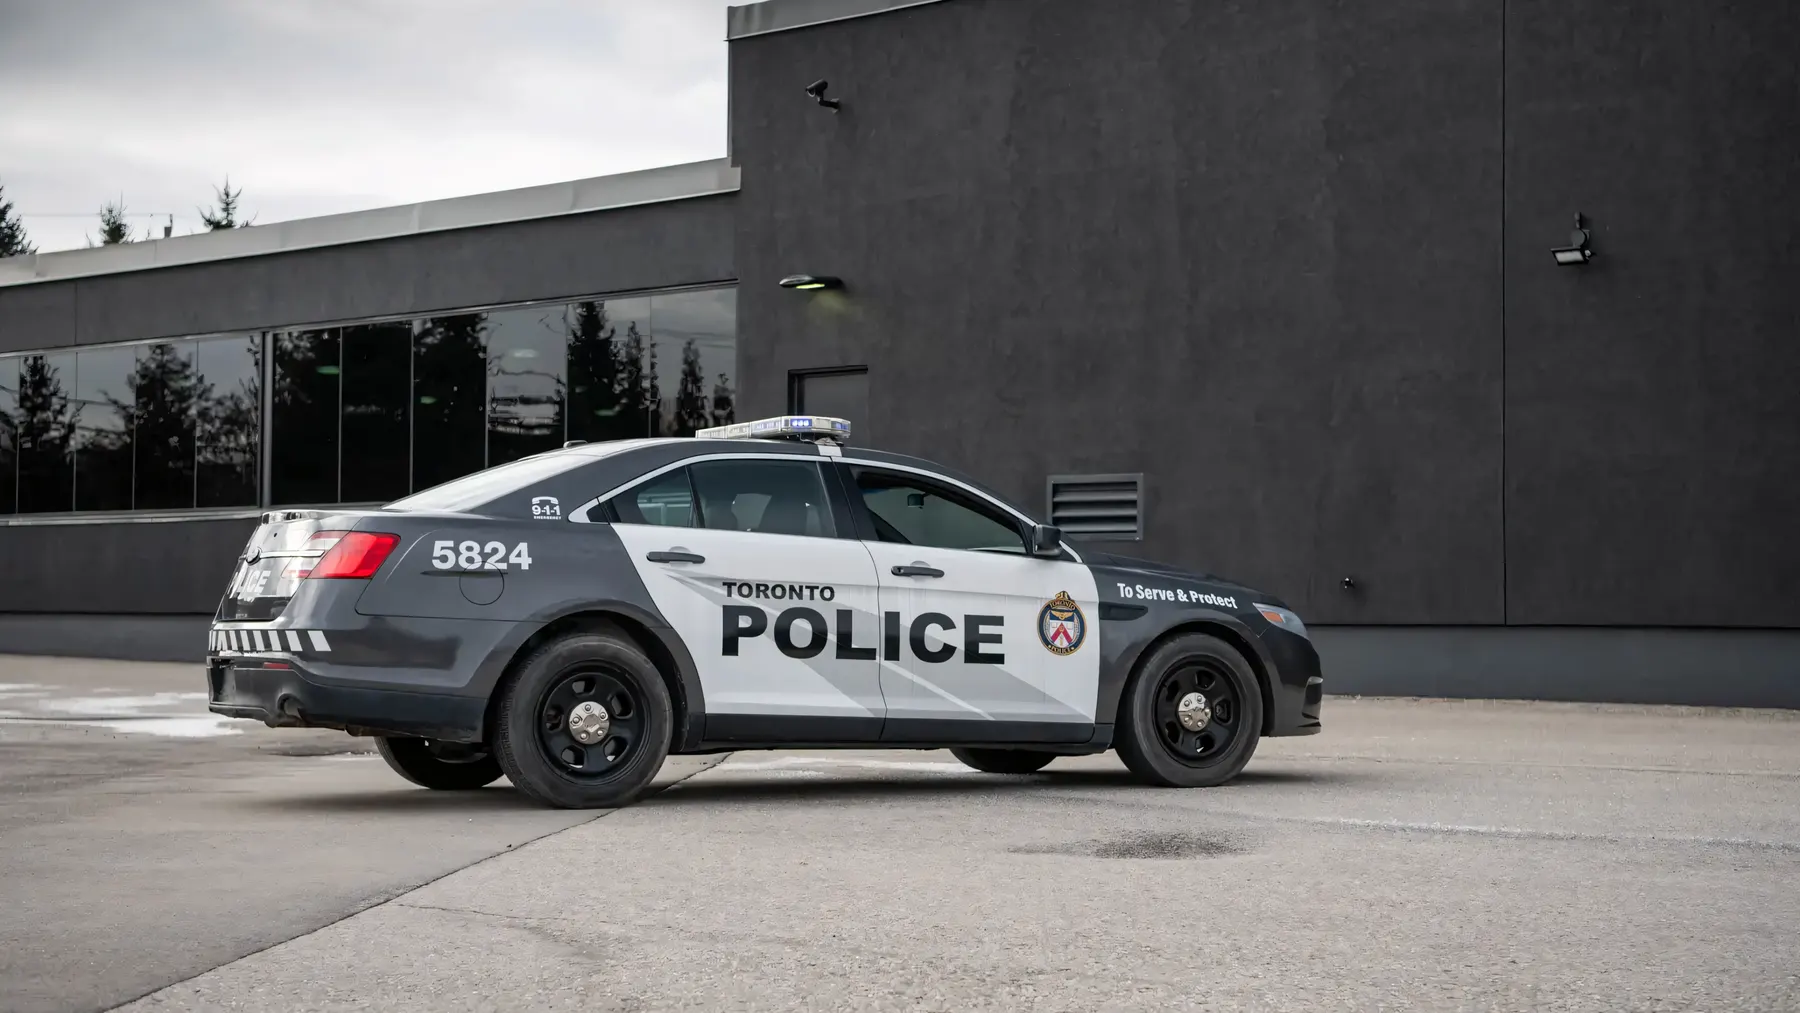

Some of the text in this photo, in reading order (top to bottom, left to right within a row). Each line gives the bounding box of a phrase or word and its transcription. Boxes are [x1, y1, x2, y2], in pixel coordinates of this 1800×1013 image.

[531, 504, 561, 516] 9-1-1
[432, 540, 532, 571] 5824
[722, 581, 835, 601] TORONTO
[1117, 582, 1238, 609] To Serve & Protect
[721, 604, 1005, 665] POLICE
